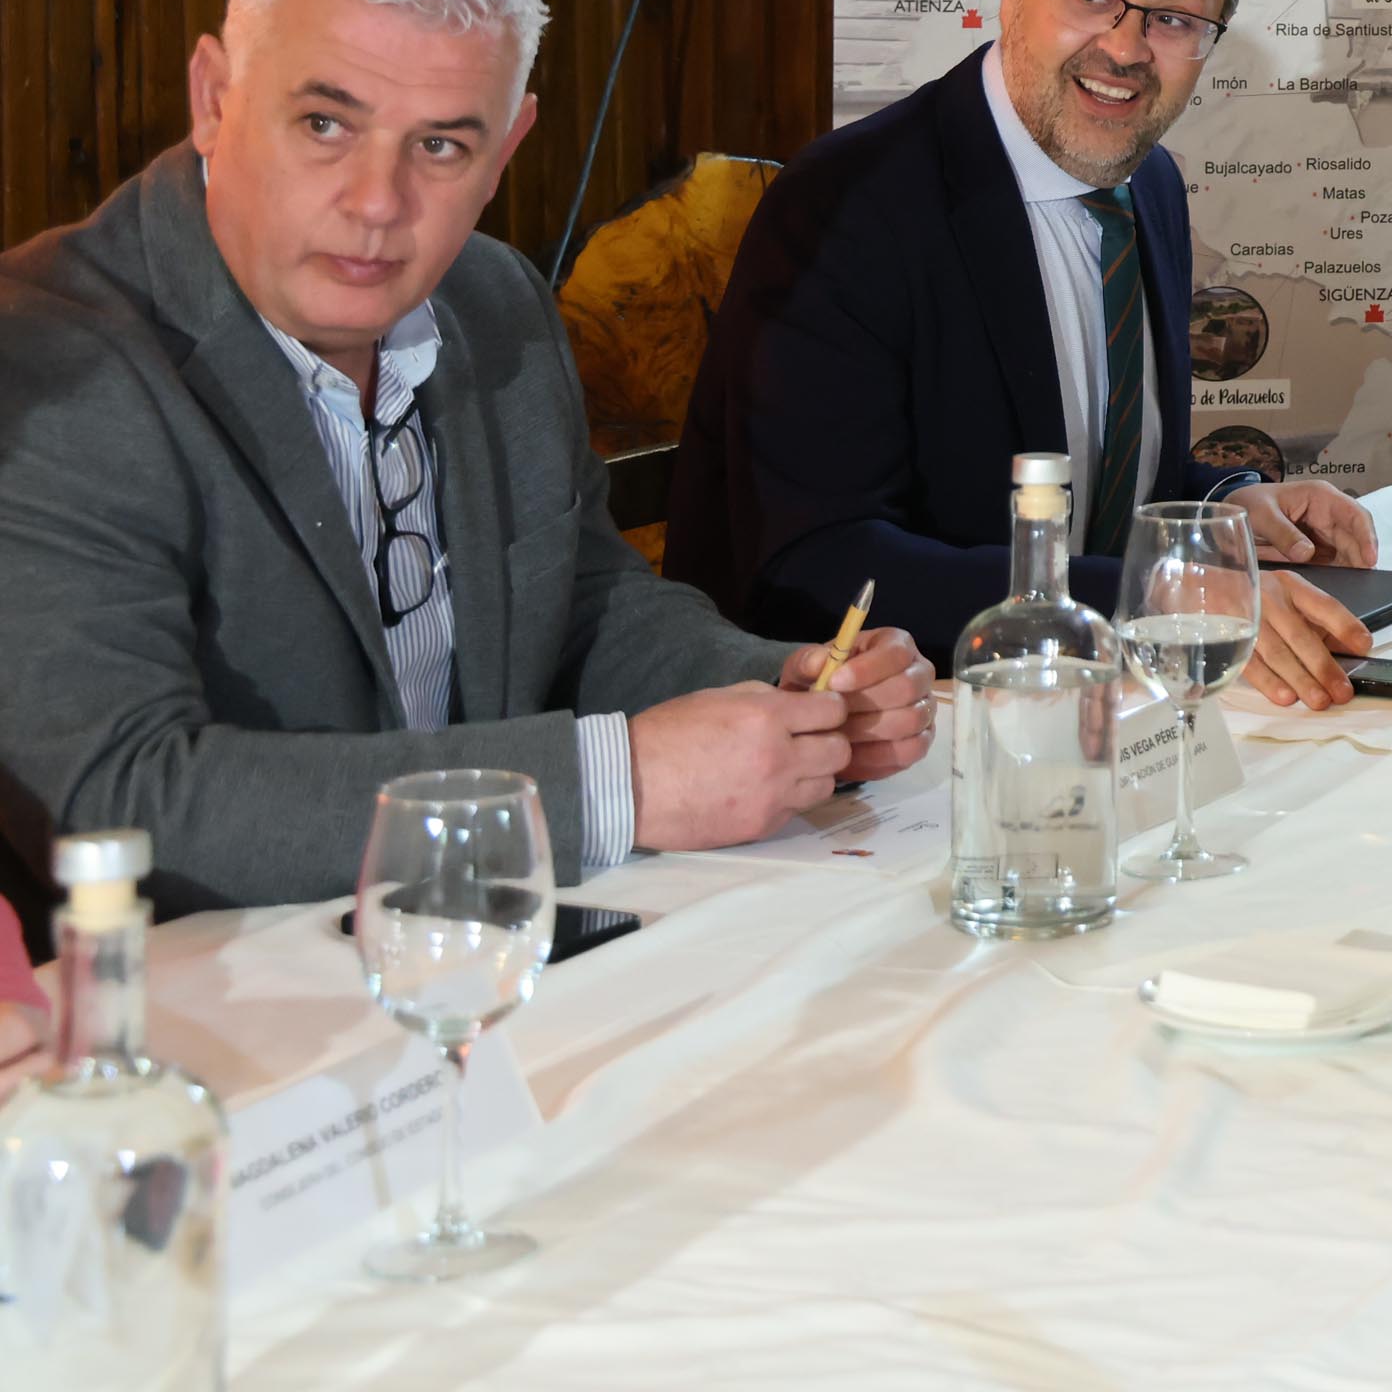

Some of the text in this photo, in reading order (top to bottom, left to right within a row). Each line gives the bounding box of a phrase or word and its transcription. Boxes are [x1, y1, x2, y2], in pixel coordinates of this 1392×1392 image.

[894, 0, 965, 13] ATIENZA
[1276, 23, 1308, 36] Riba
[1313, 23, 1330, 36] de
[1212, 76, 1247, 90] Imón
[1278, 77, 1358, 91] La Barbolla
[1205, 161, 1292, 178] Bujalcayado
[1306, 157, 1371, 171] Riosalido
[1322, 186, 1366, 200] Matas
[1330, 227, 1363, 240] Ures
[1230, 242, 1294, 256] Carabias
[1304, 260, 1381, 274] Palazuelos
[1201, 389, 1215, 405] de
[1218, 389, 1285, 405] Palazuelos
[1287, 462, 1366, 475] La Cabrera
[1130, 736, 1158, 757] VEGA
[1154, 725, 1185, 747] PÉRE
